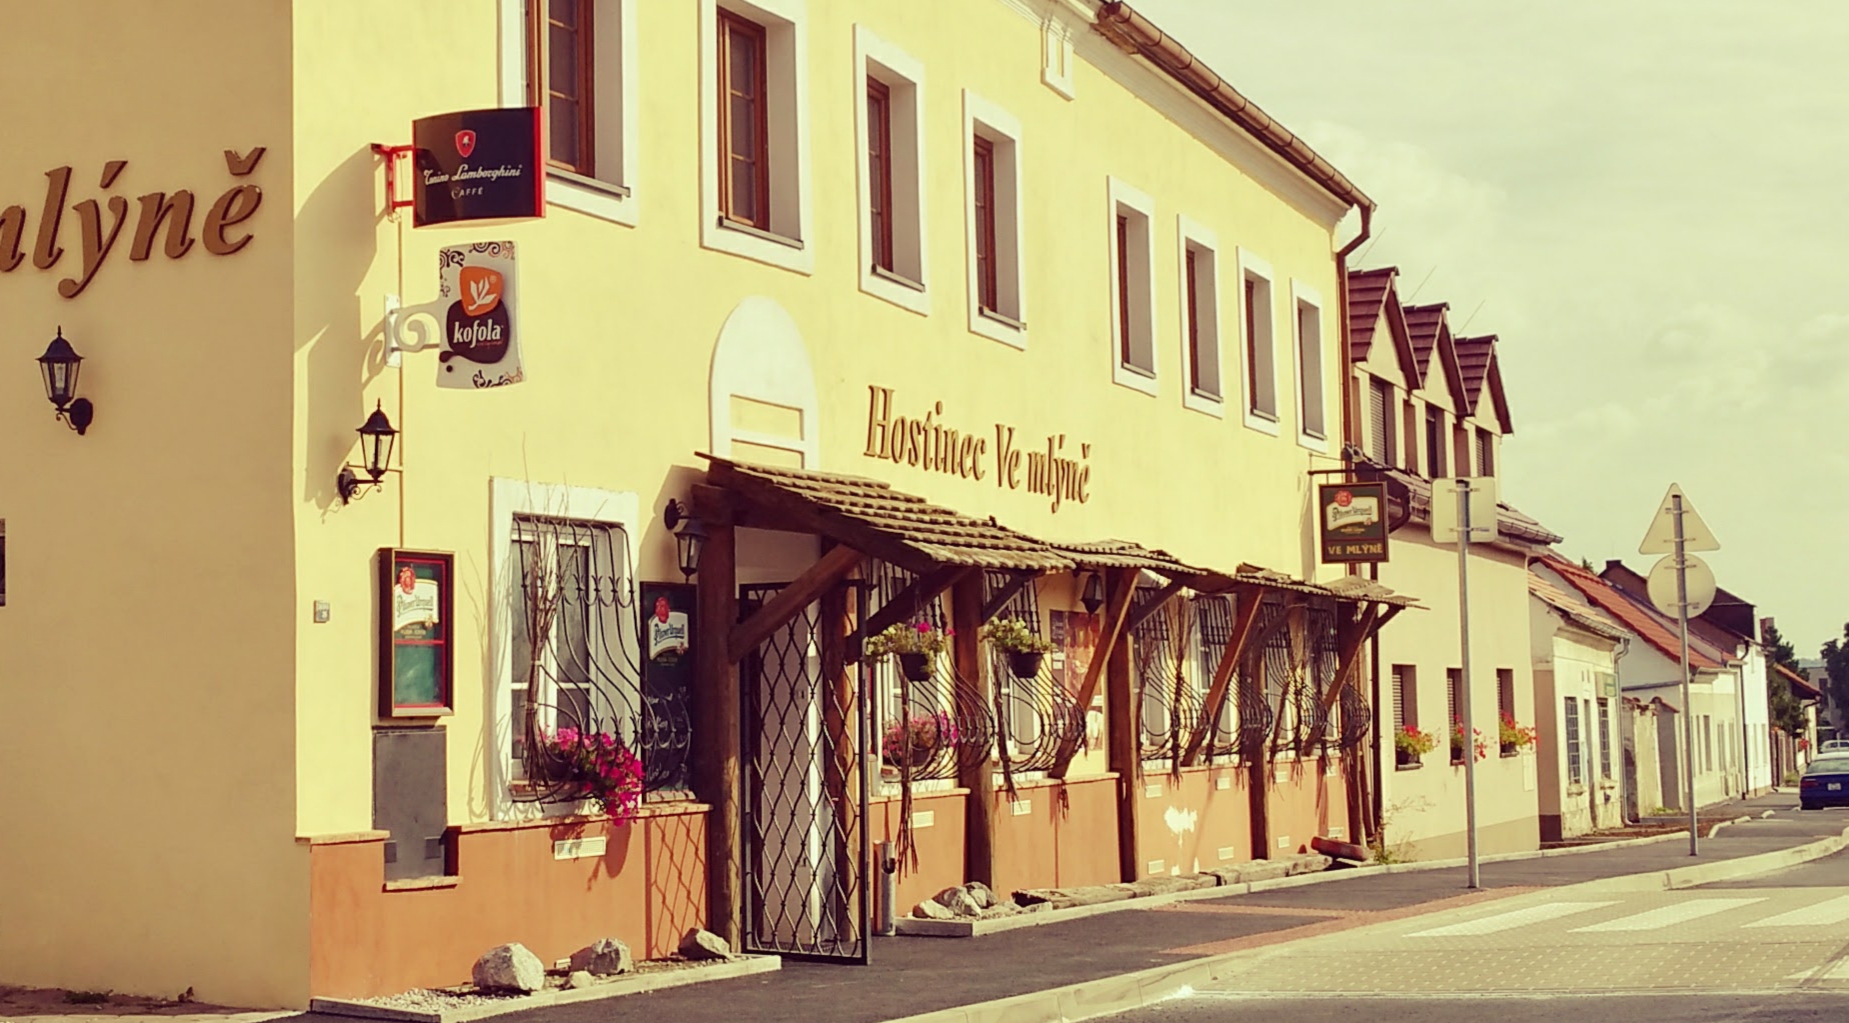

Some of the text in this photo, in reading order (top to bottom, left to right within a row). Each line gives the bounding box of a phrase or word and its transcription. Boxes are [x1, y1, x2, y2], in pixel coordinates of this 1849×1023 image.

[451, 163, 523, 181] Lamborghini
[0, 147, 267, 298] lýně
[453, 318, 501, 348] kofola
[863, 385, 1092, 514] Hostinec Ve mlýně
[1328, 546, 1342, 555] VE
